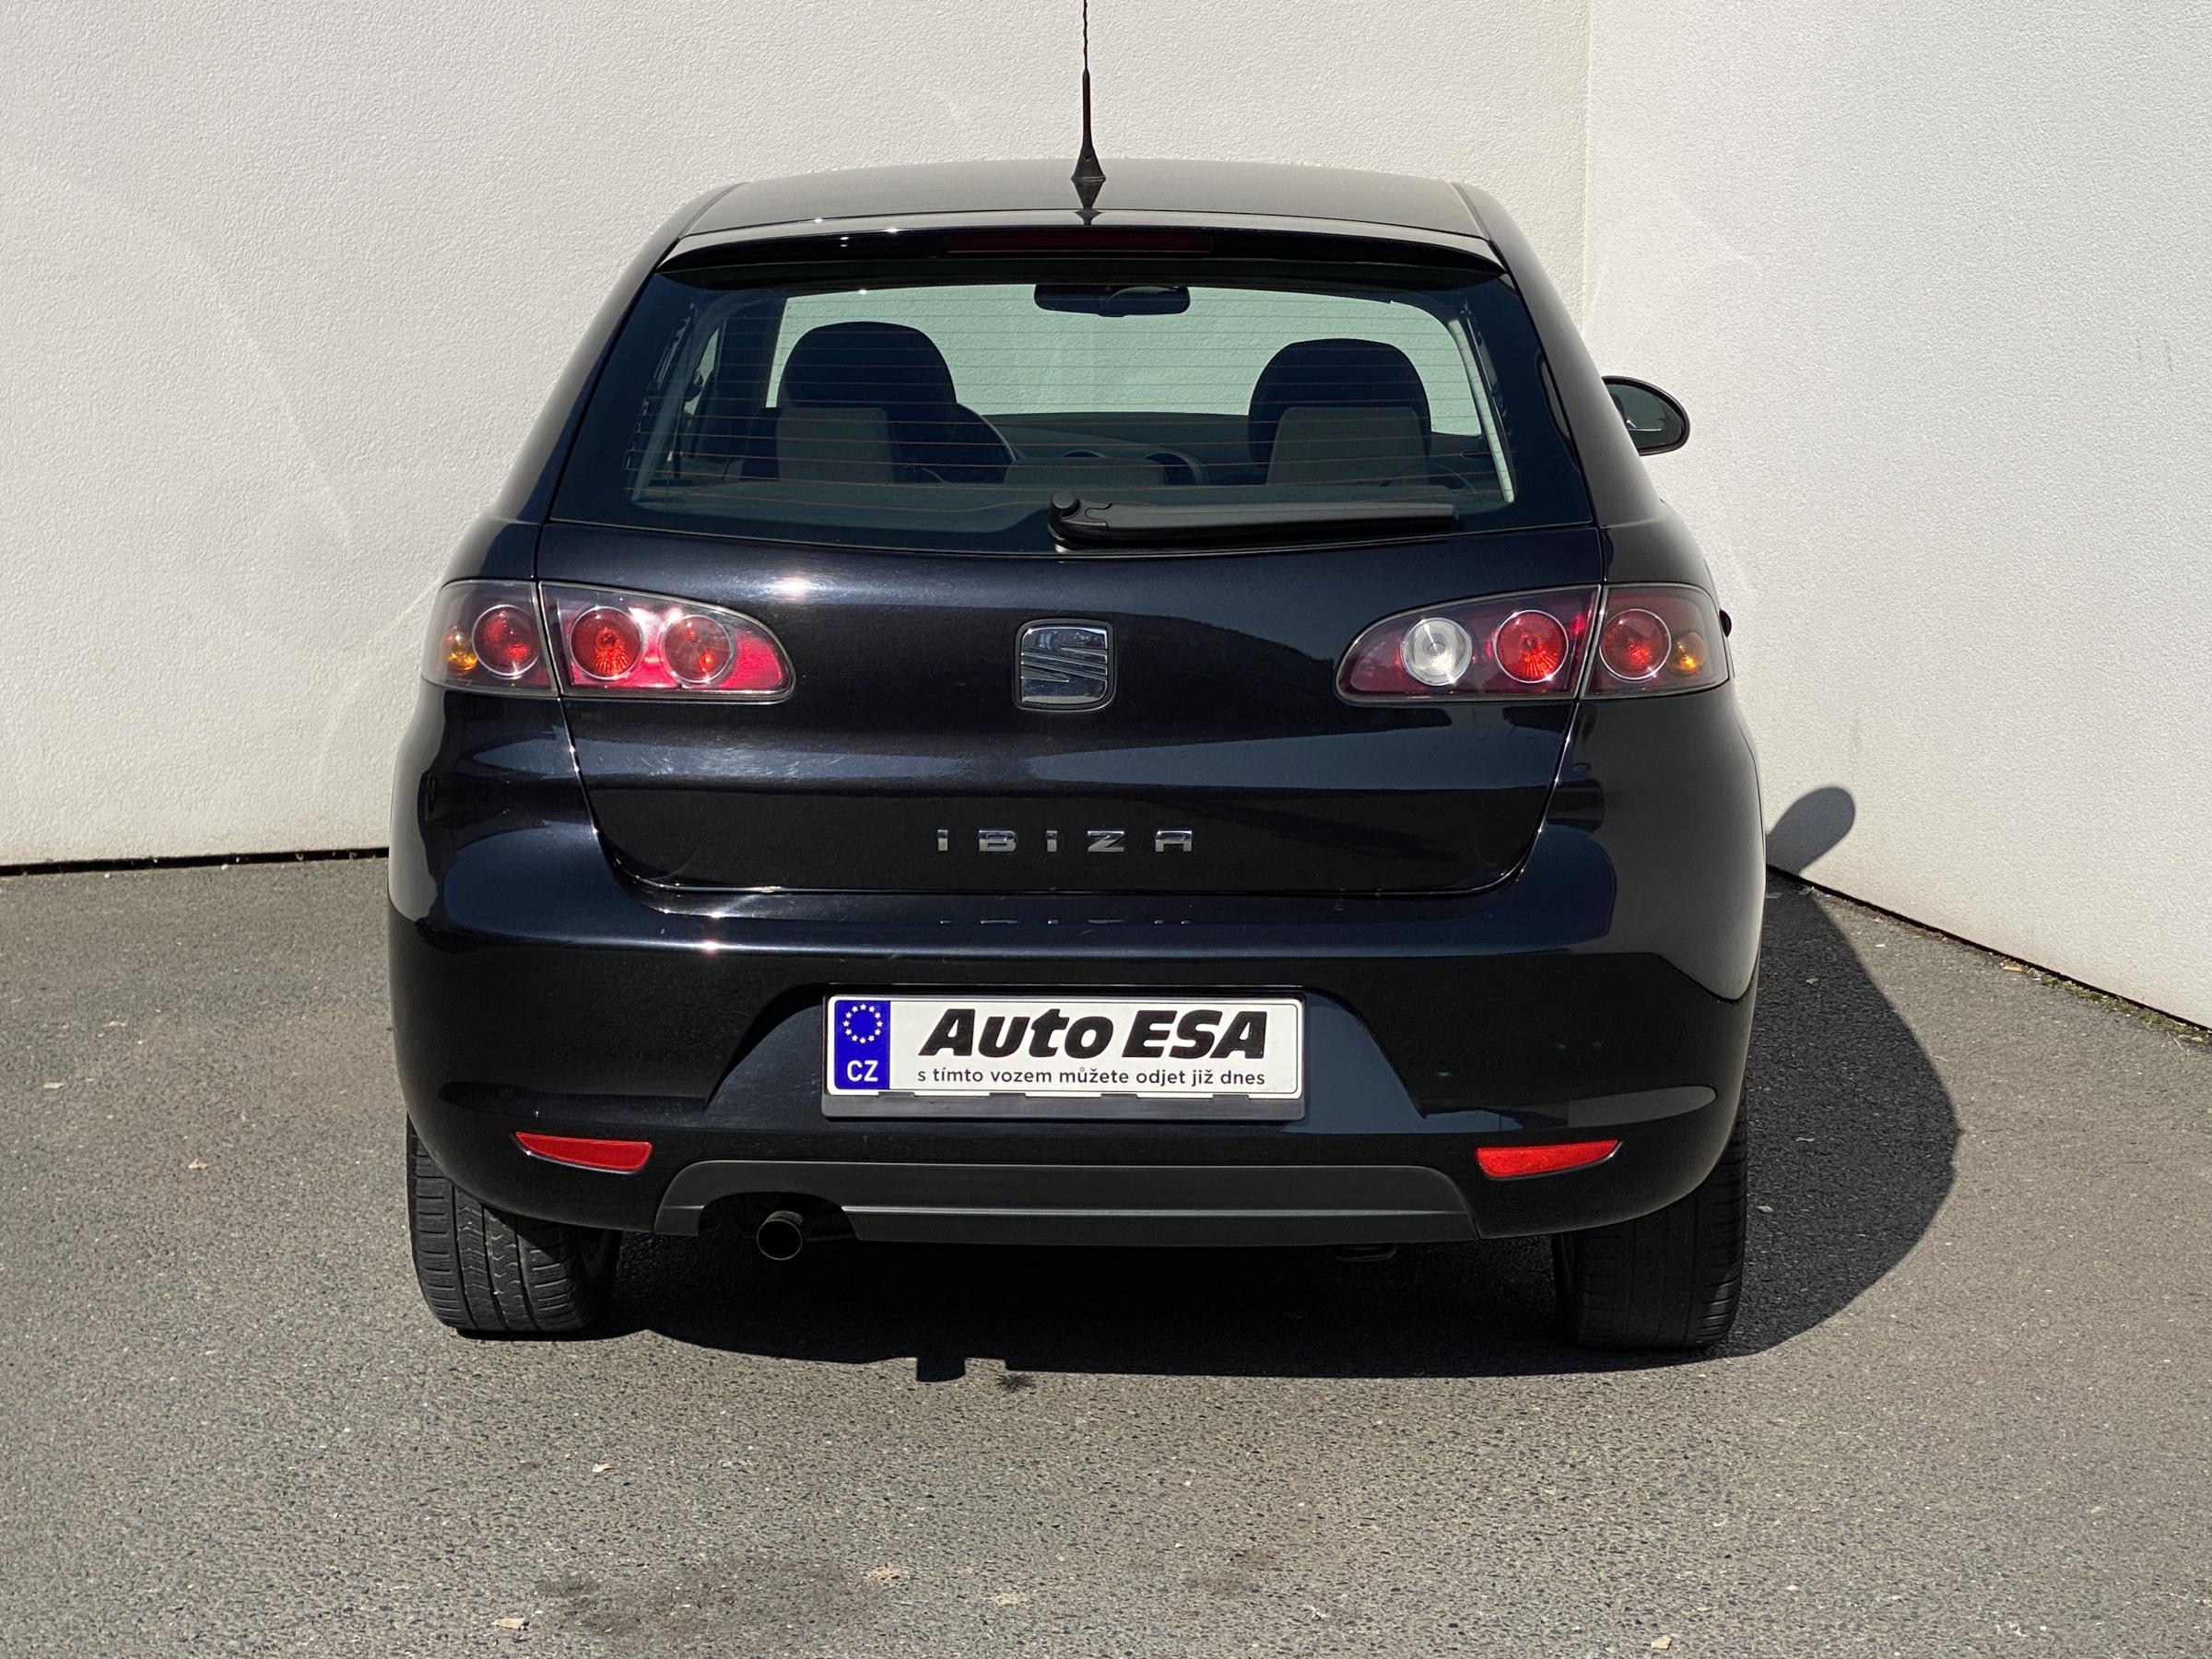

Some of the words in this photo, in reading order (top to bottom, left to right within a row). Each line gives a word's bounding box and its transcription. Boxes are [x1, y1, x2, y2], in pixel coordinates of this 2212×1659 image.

[937, 830, 1193, 853] IBIZA
[918, 1008, 1114, 1059] Auto
[1122, 1009, 1268, 1060] ESA
[846, 1060, 878, 1082] CZ
[917, 1070, 926, 1082] s
[933, 1066, 983, 1083] tímto
[990, 1071, 1053, 1083] vozem
[1059, 1066, 1129, 1084] můžete
[1135, 1069, 1186, 1087] odjet
[1191, 1069, 1214, 1088] již
[1220, 1069, 1265, 1085] dnes
